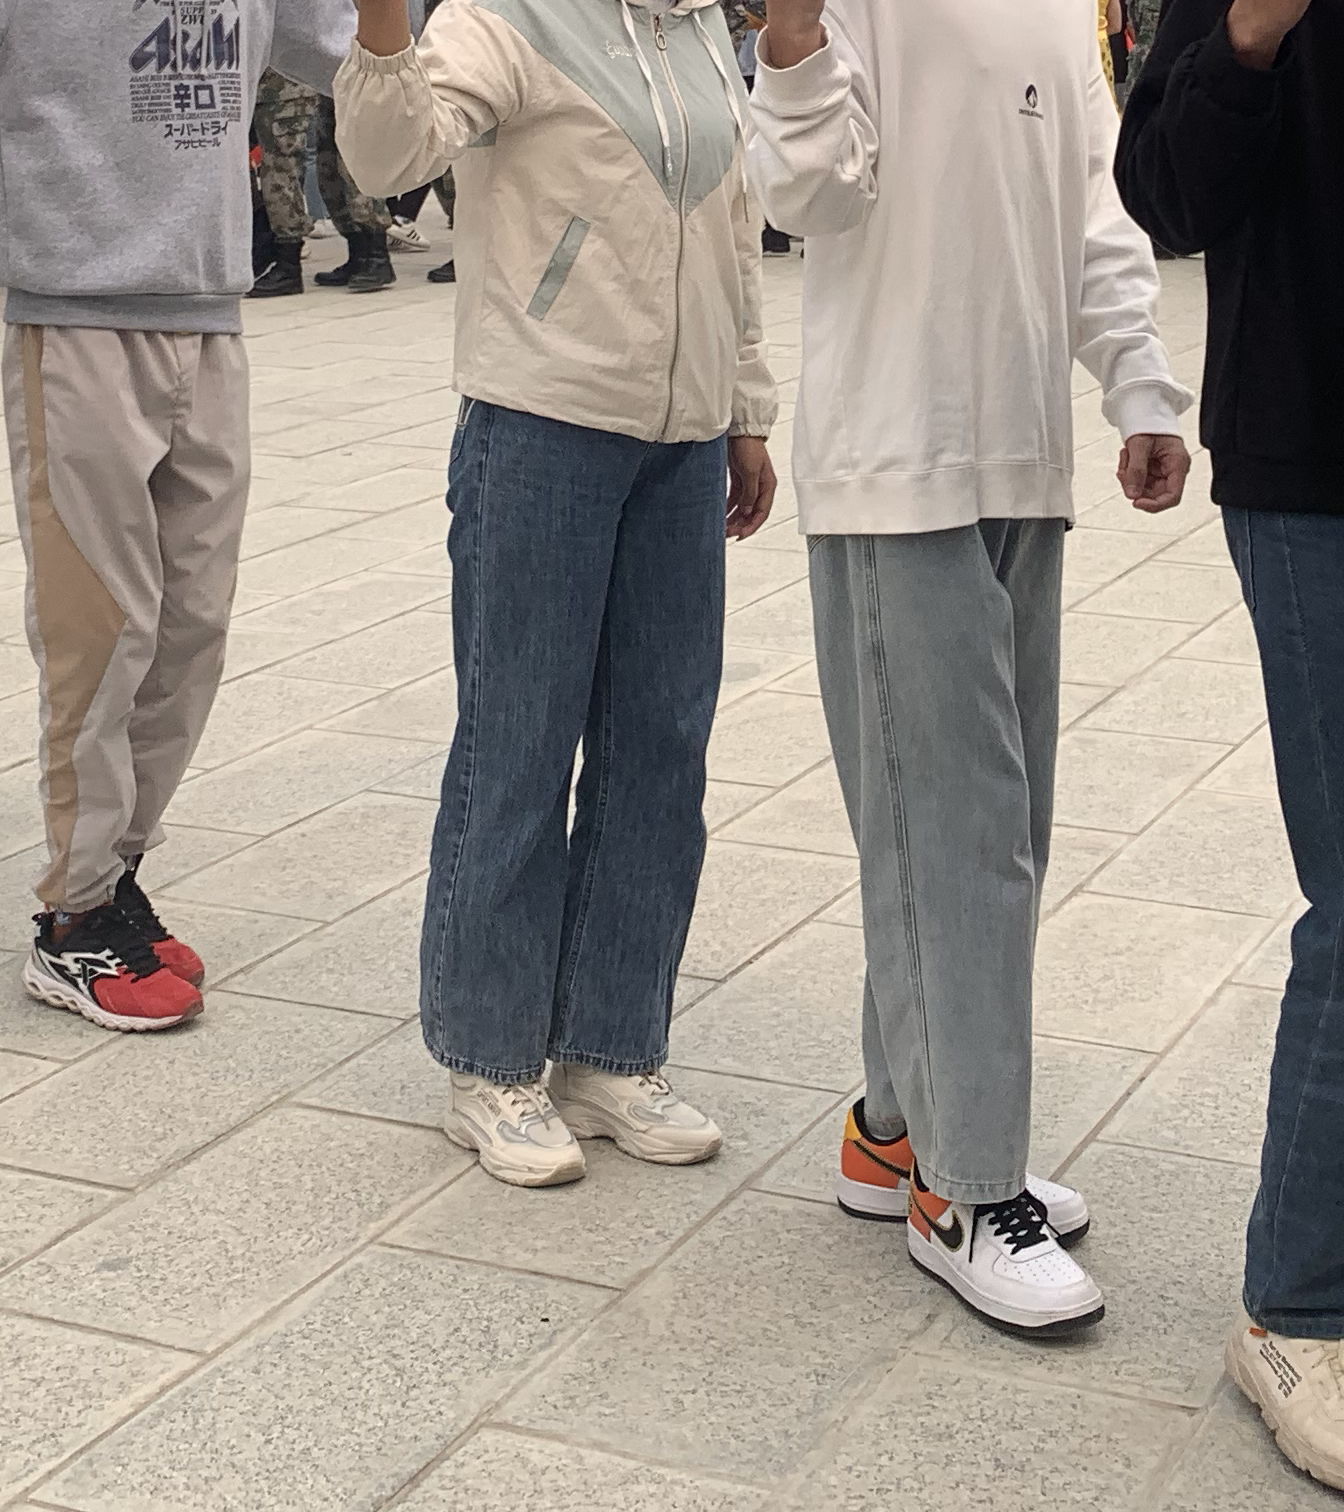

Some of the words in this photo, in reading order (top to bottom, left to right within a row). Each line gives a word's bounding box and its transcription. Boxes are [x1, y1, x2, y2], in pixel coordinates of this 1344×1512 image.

[173, 82, 216, 113] 辛口
[164, 120, 229, 139] スーパードライ
